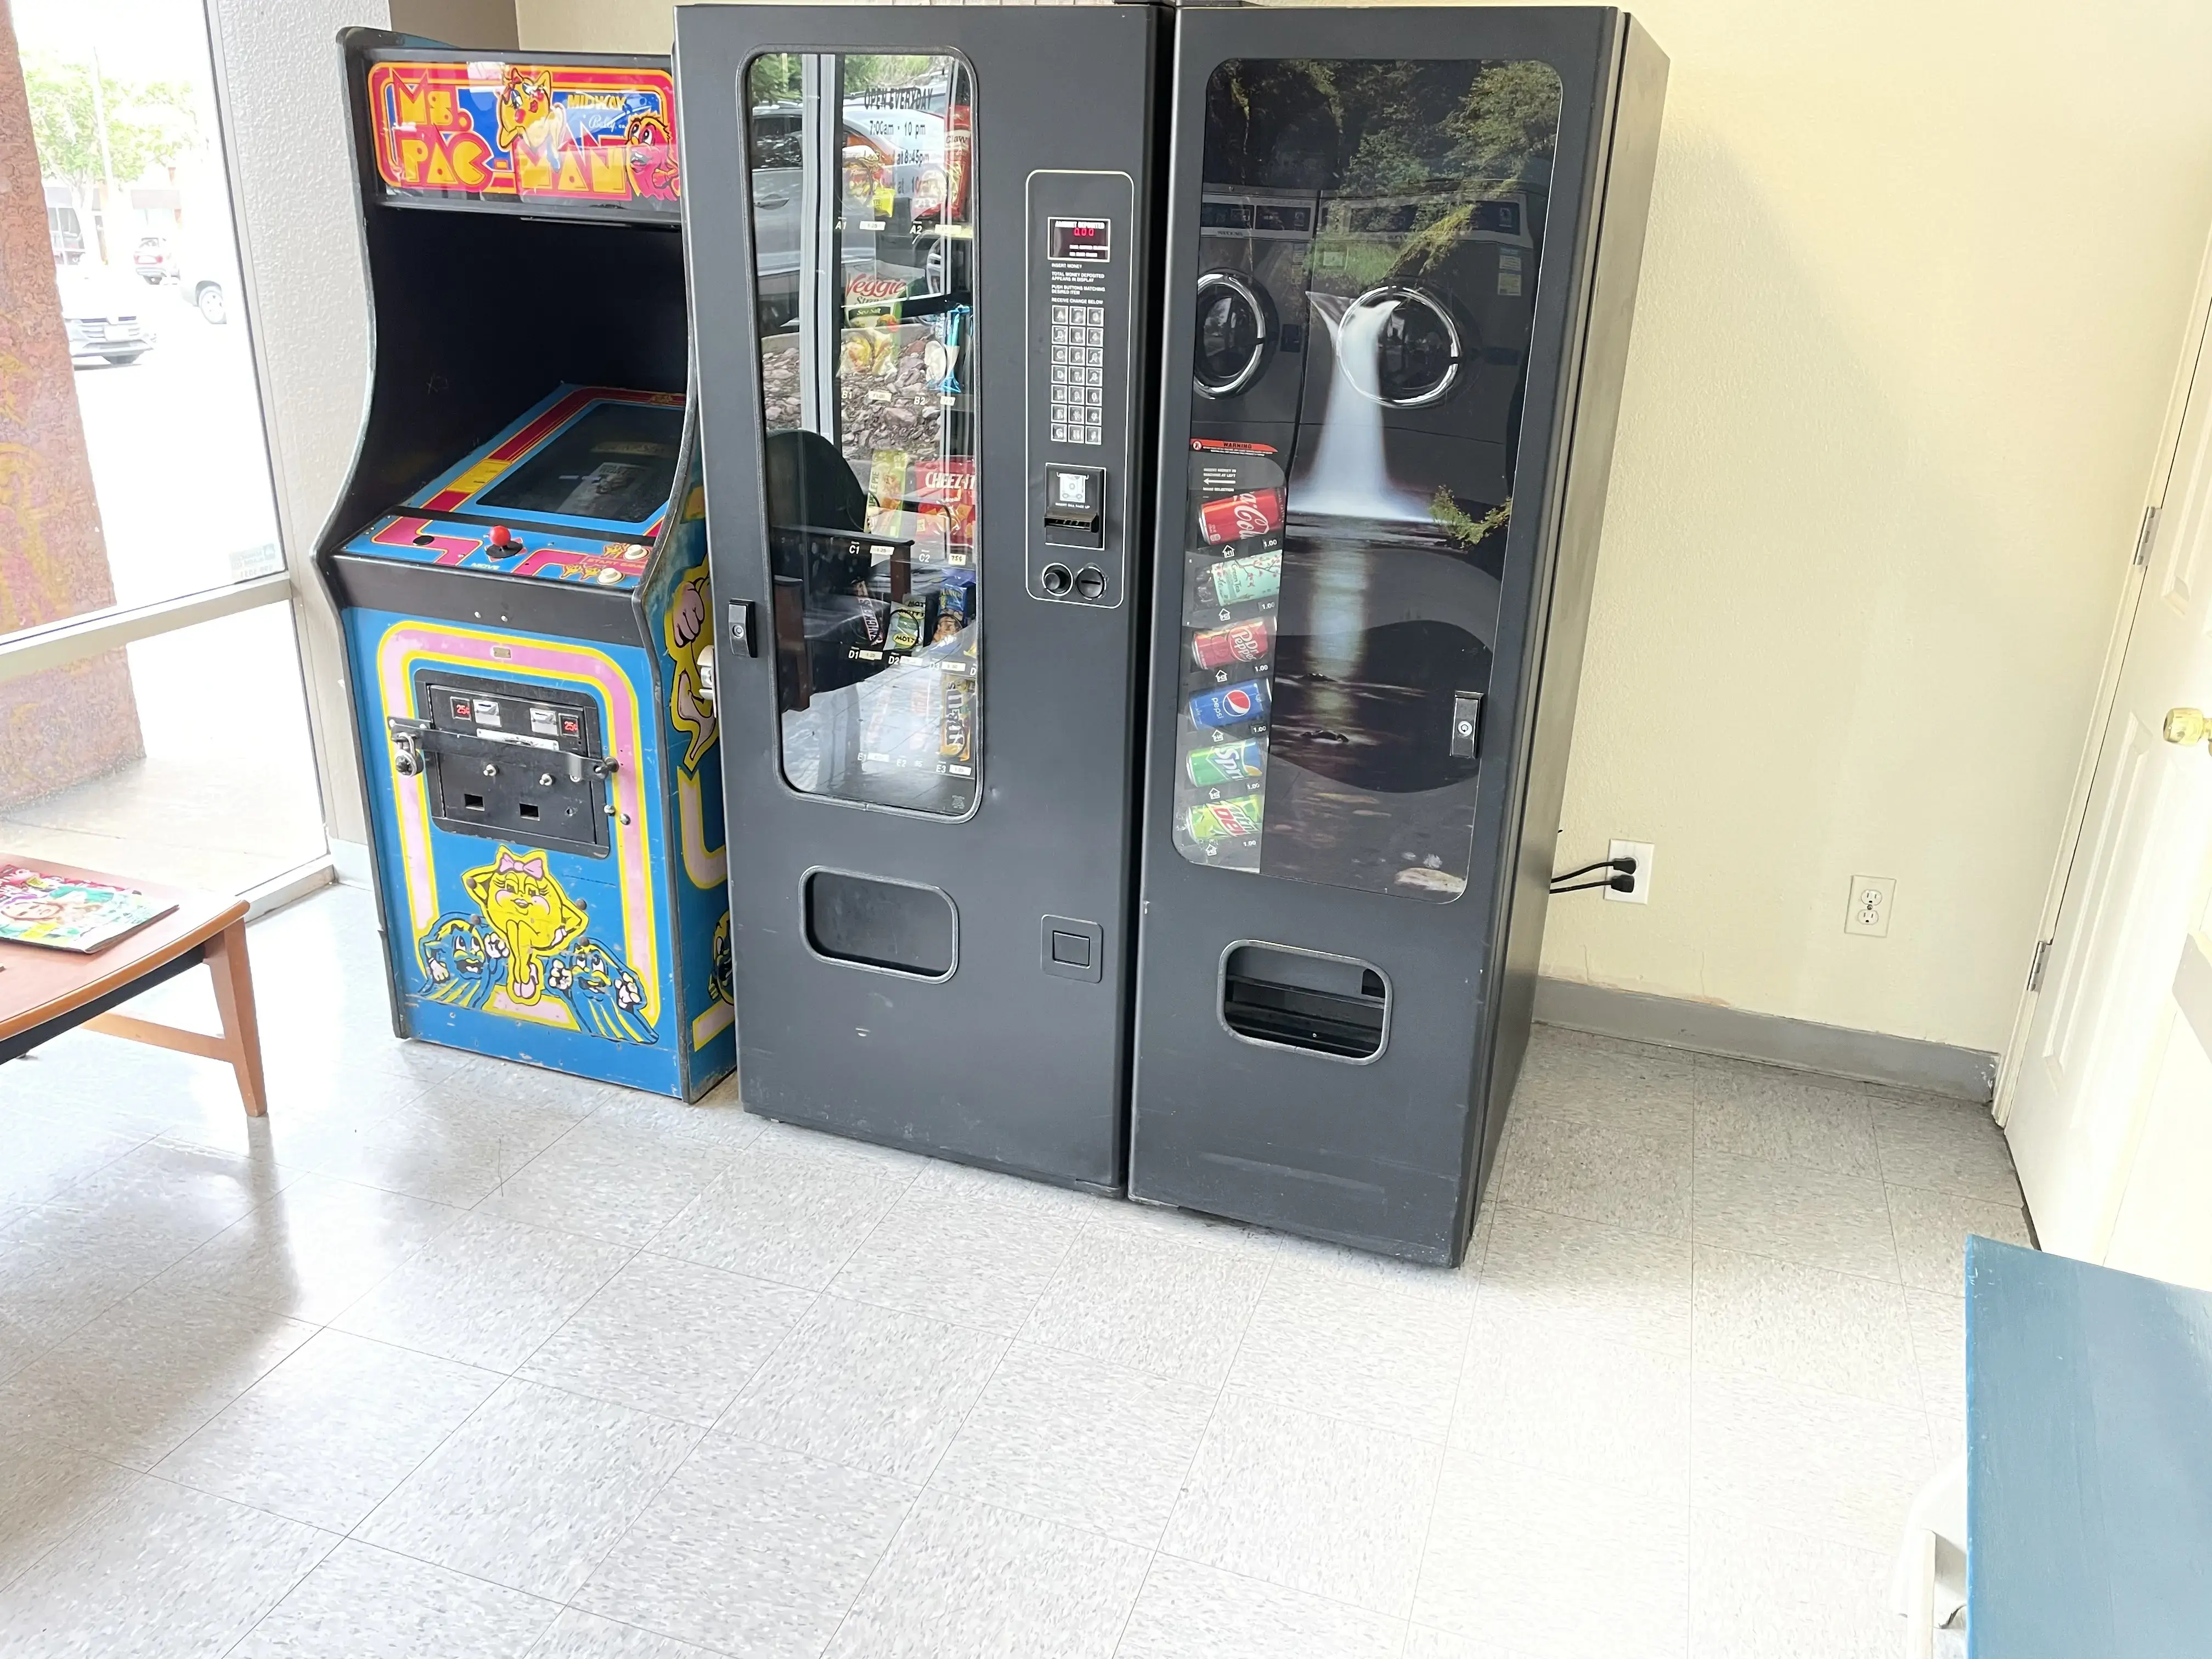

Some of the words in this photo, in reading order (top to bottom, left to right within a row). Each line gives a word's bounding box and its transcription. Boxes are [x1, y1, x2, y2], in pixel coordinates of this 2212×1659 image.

[864, 88, 888, 110] OPEN
[889, 87, 934, 110] EVERYDAY
[909, 225, 923, 234] A2
[846, 273, 907, 297] Veggie
[913, 396, 926, 405] B2
[1263, 539, 1277, 547] 1.00
[849, 545, 860, 555] C1
[918, 553, 930, 563] C2
[1231, 630, 1257, 661] Pepper
[1244, 640, 1259, 654] Dr
[848, 650, 860, 659] D1
[888, 656, 900, 665] D2
[1211, 697, 1224, 719] pepsi
[935, 764, 946, 774] E3
